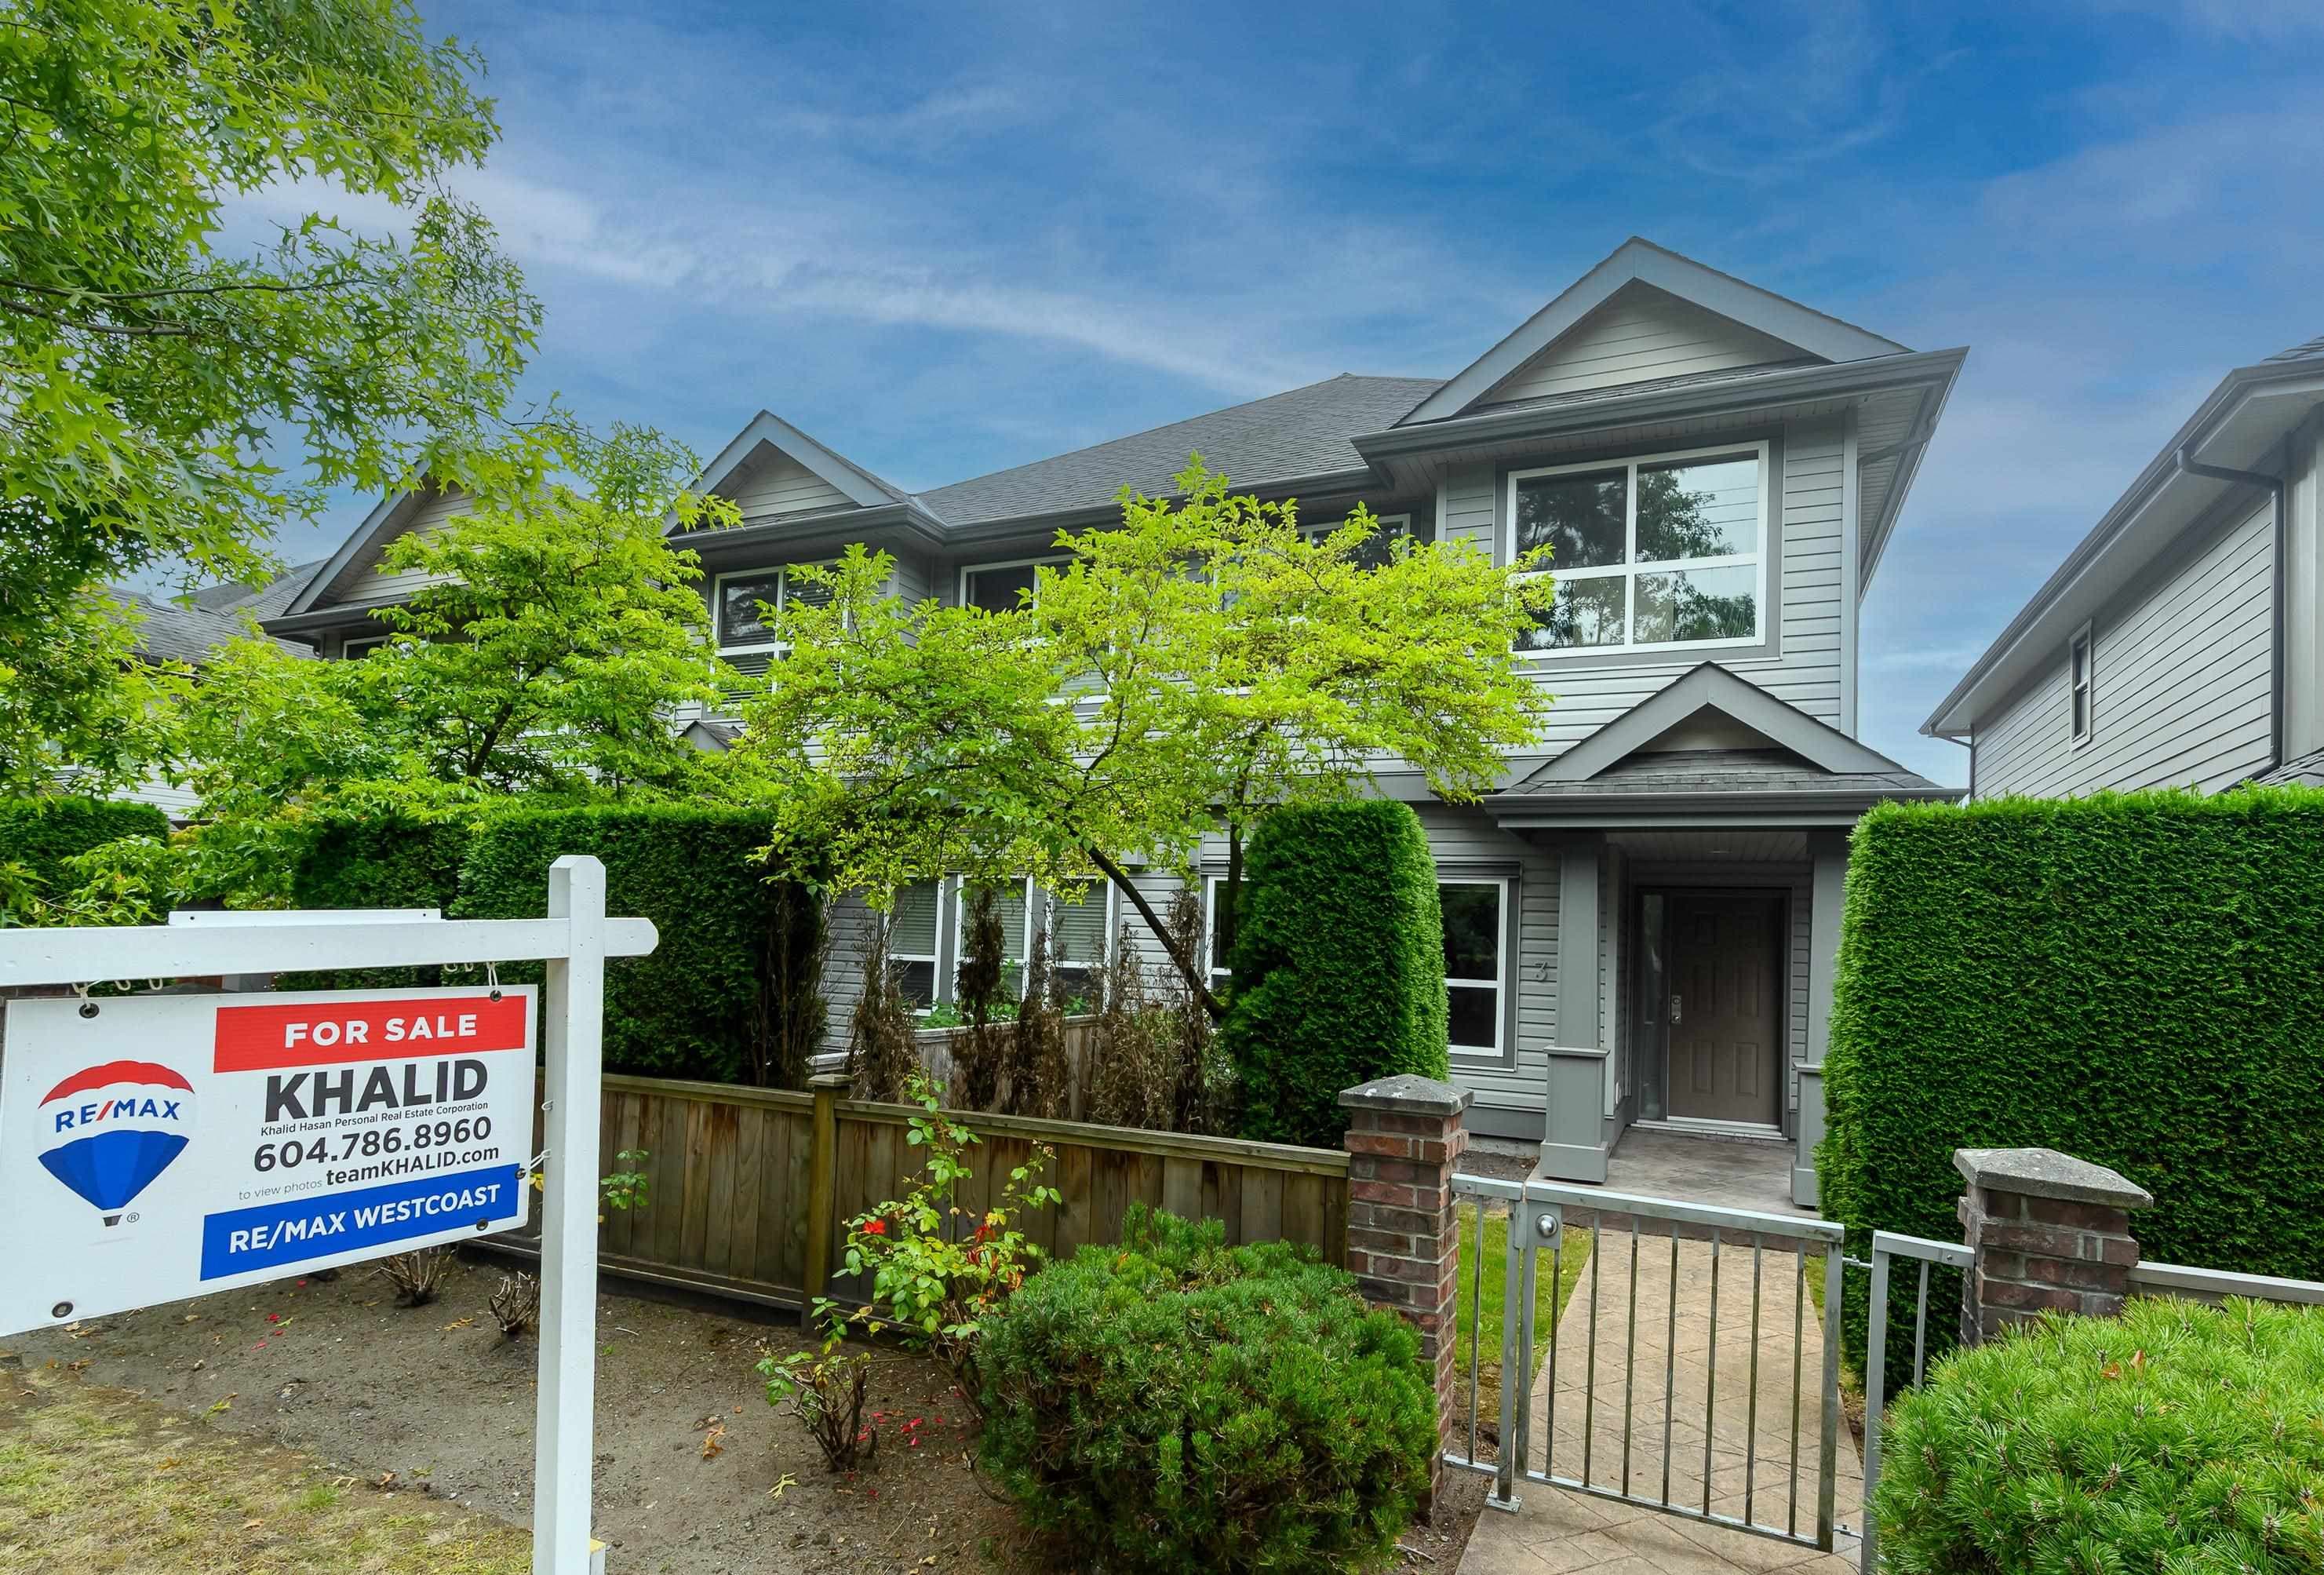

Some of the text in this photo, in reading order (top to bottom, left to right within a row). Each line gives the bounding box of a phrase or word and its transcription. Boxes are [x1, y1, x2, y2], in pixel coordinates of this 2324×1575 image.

[285, 1014, 478, 1048] FOR SALE
[56, 1098, 181, 1133] RE/MAX
[264, 1059, 489, 1123] KHALID
[253, 1116, 492, 1172] 604.786.8960
[260, 1101, 489, 1137] Khalid Hasan Personal Real Estate Corporation
[239, 1146, 500, 1201] to view photos teamKHALID.com
[229, 1183, 501, 1255] RE/MAX WESTCOAST
